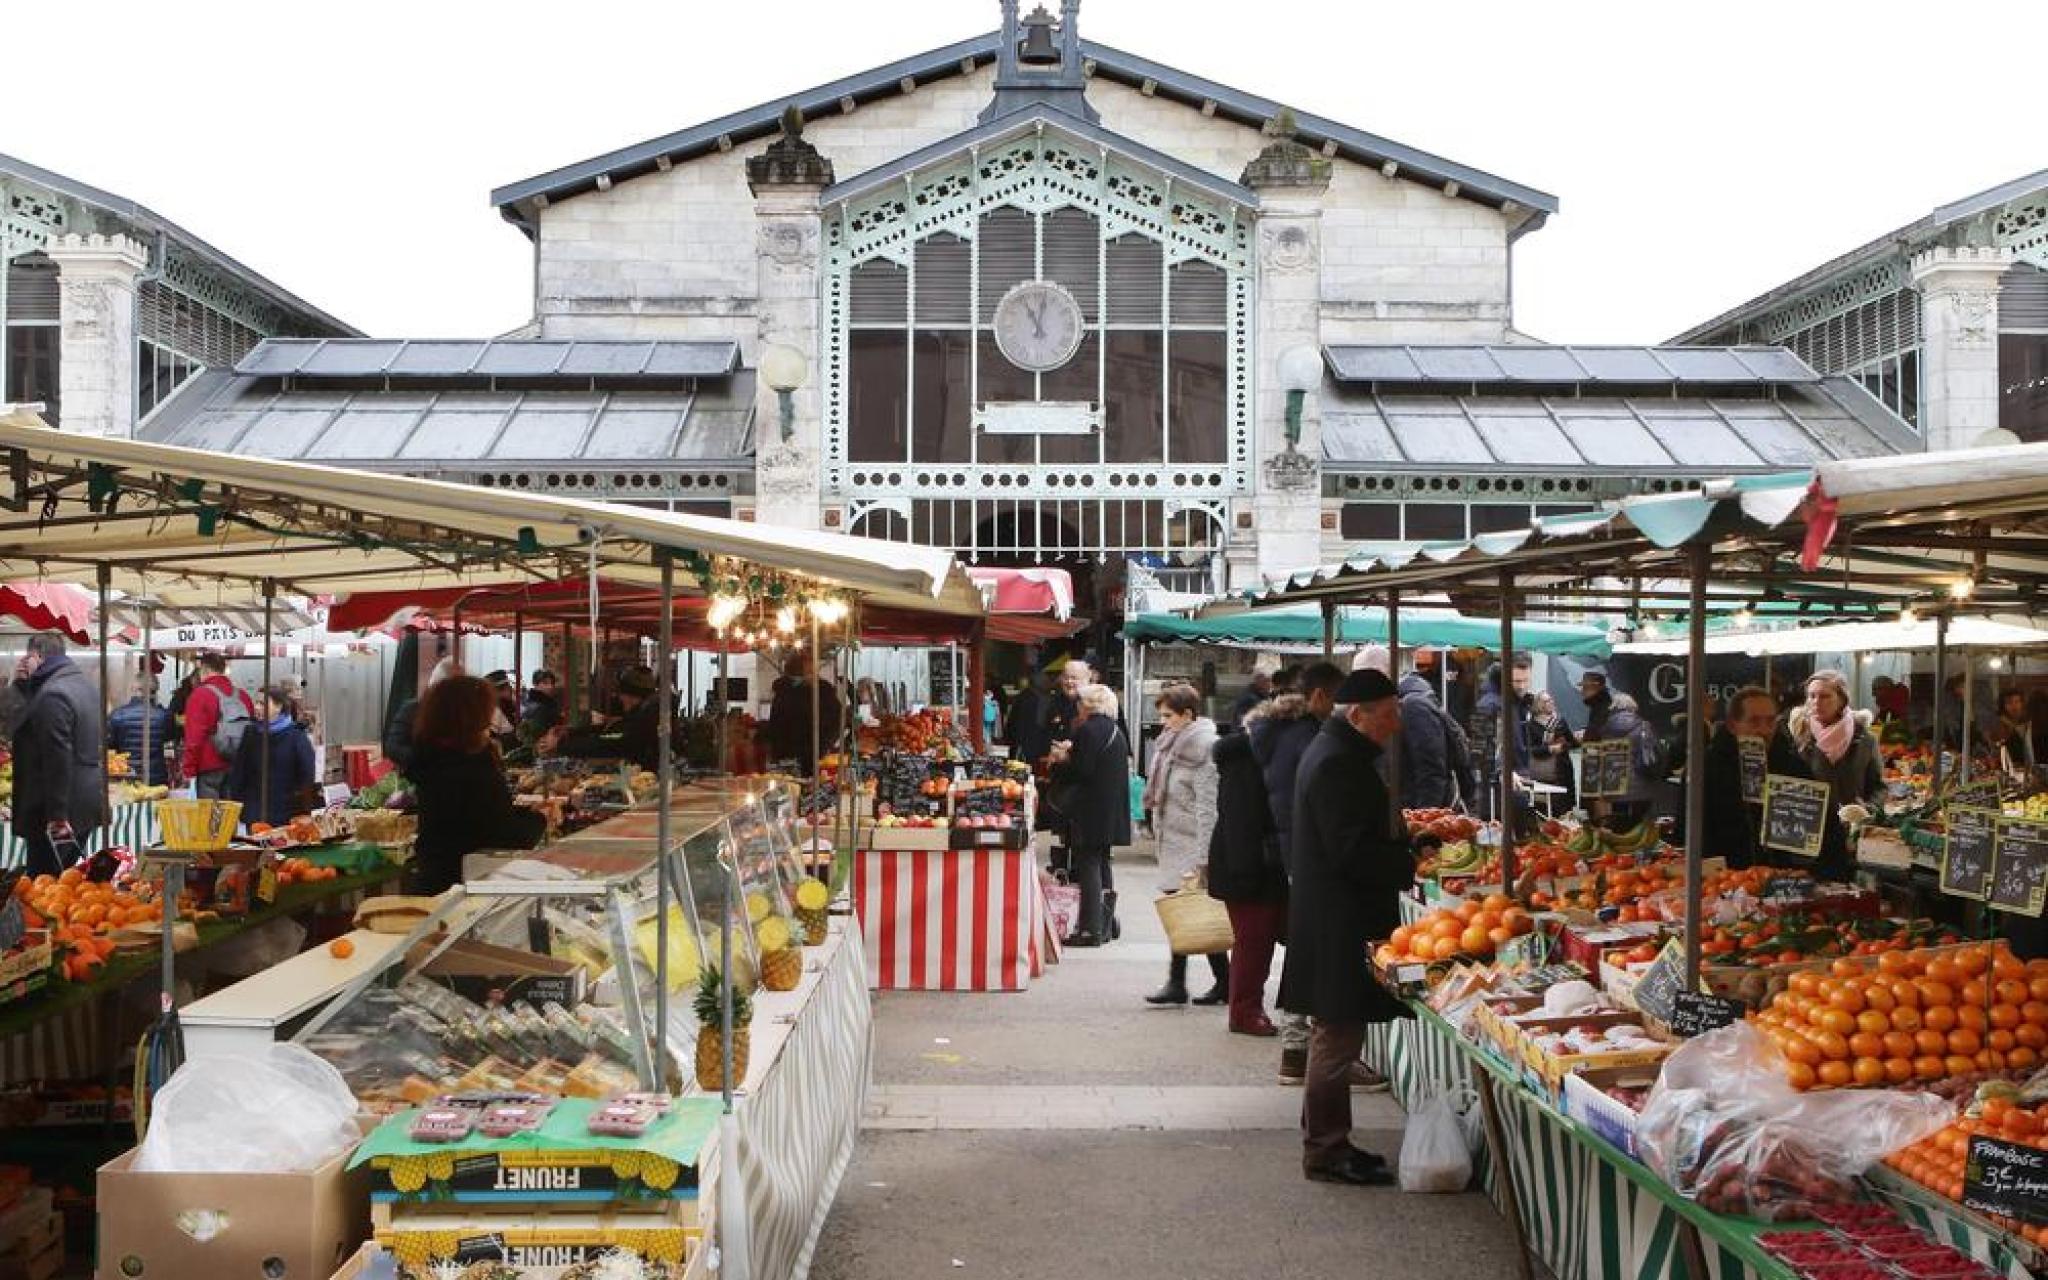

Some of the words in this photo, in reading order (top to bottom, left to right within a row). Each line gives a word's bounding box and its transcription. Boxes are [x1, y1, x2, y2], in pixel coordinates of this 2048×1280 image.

[177, 629, 196, 642] DU
[203, 627, 238, 641] PAYS
[493, 1167, 581, 1190] FRUNET
